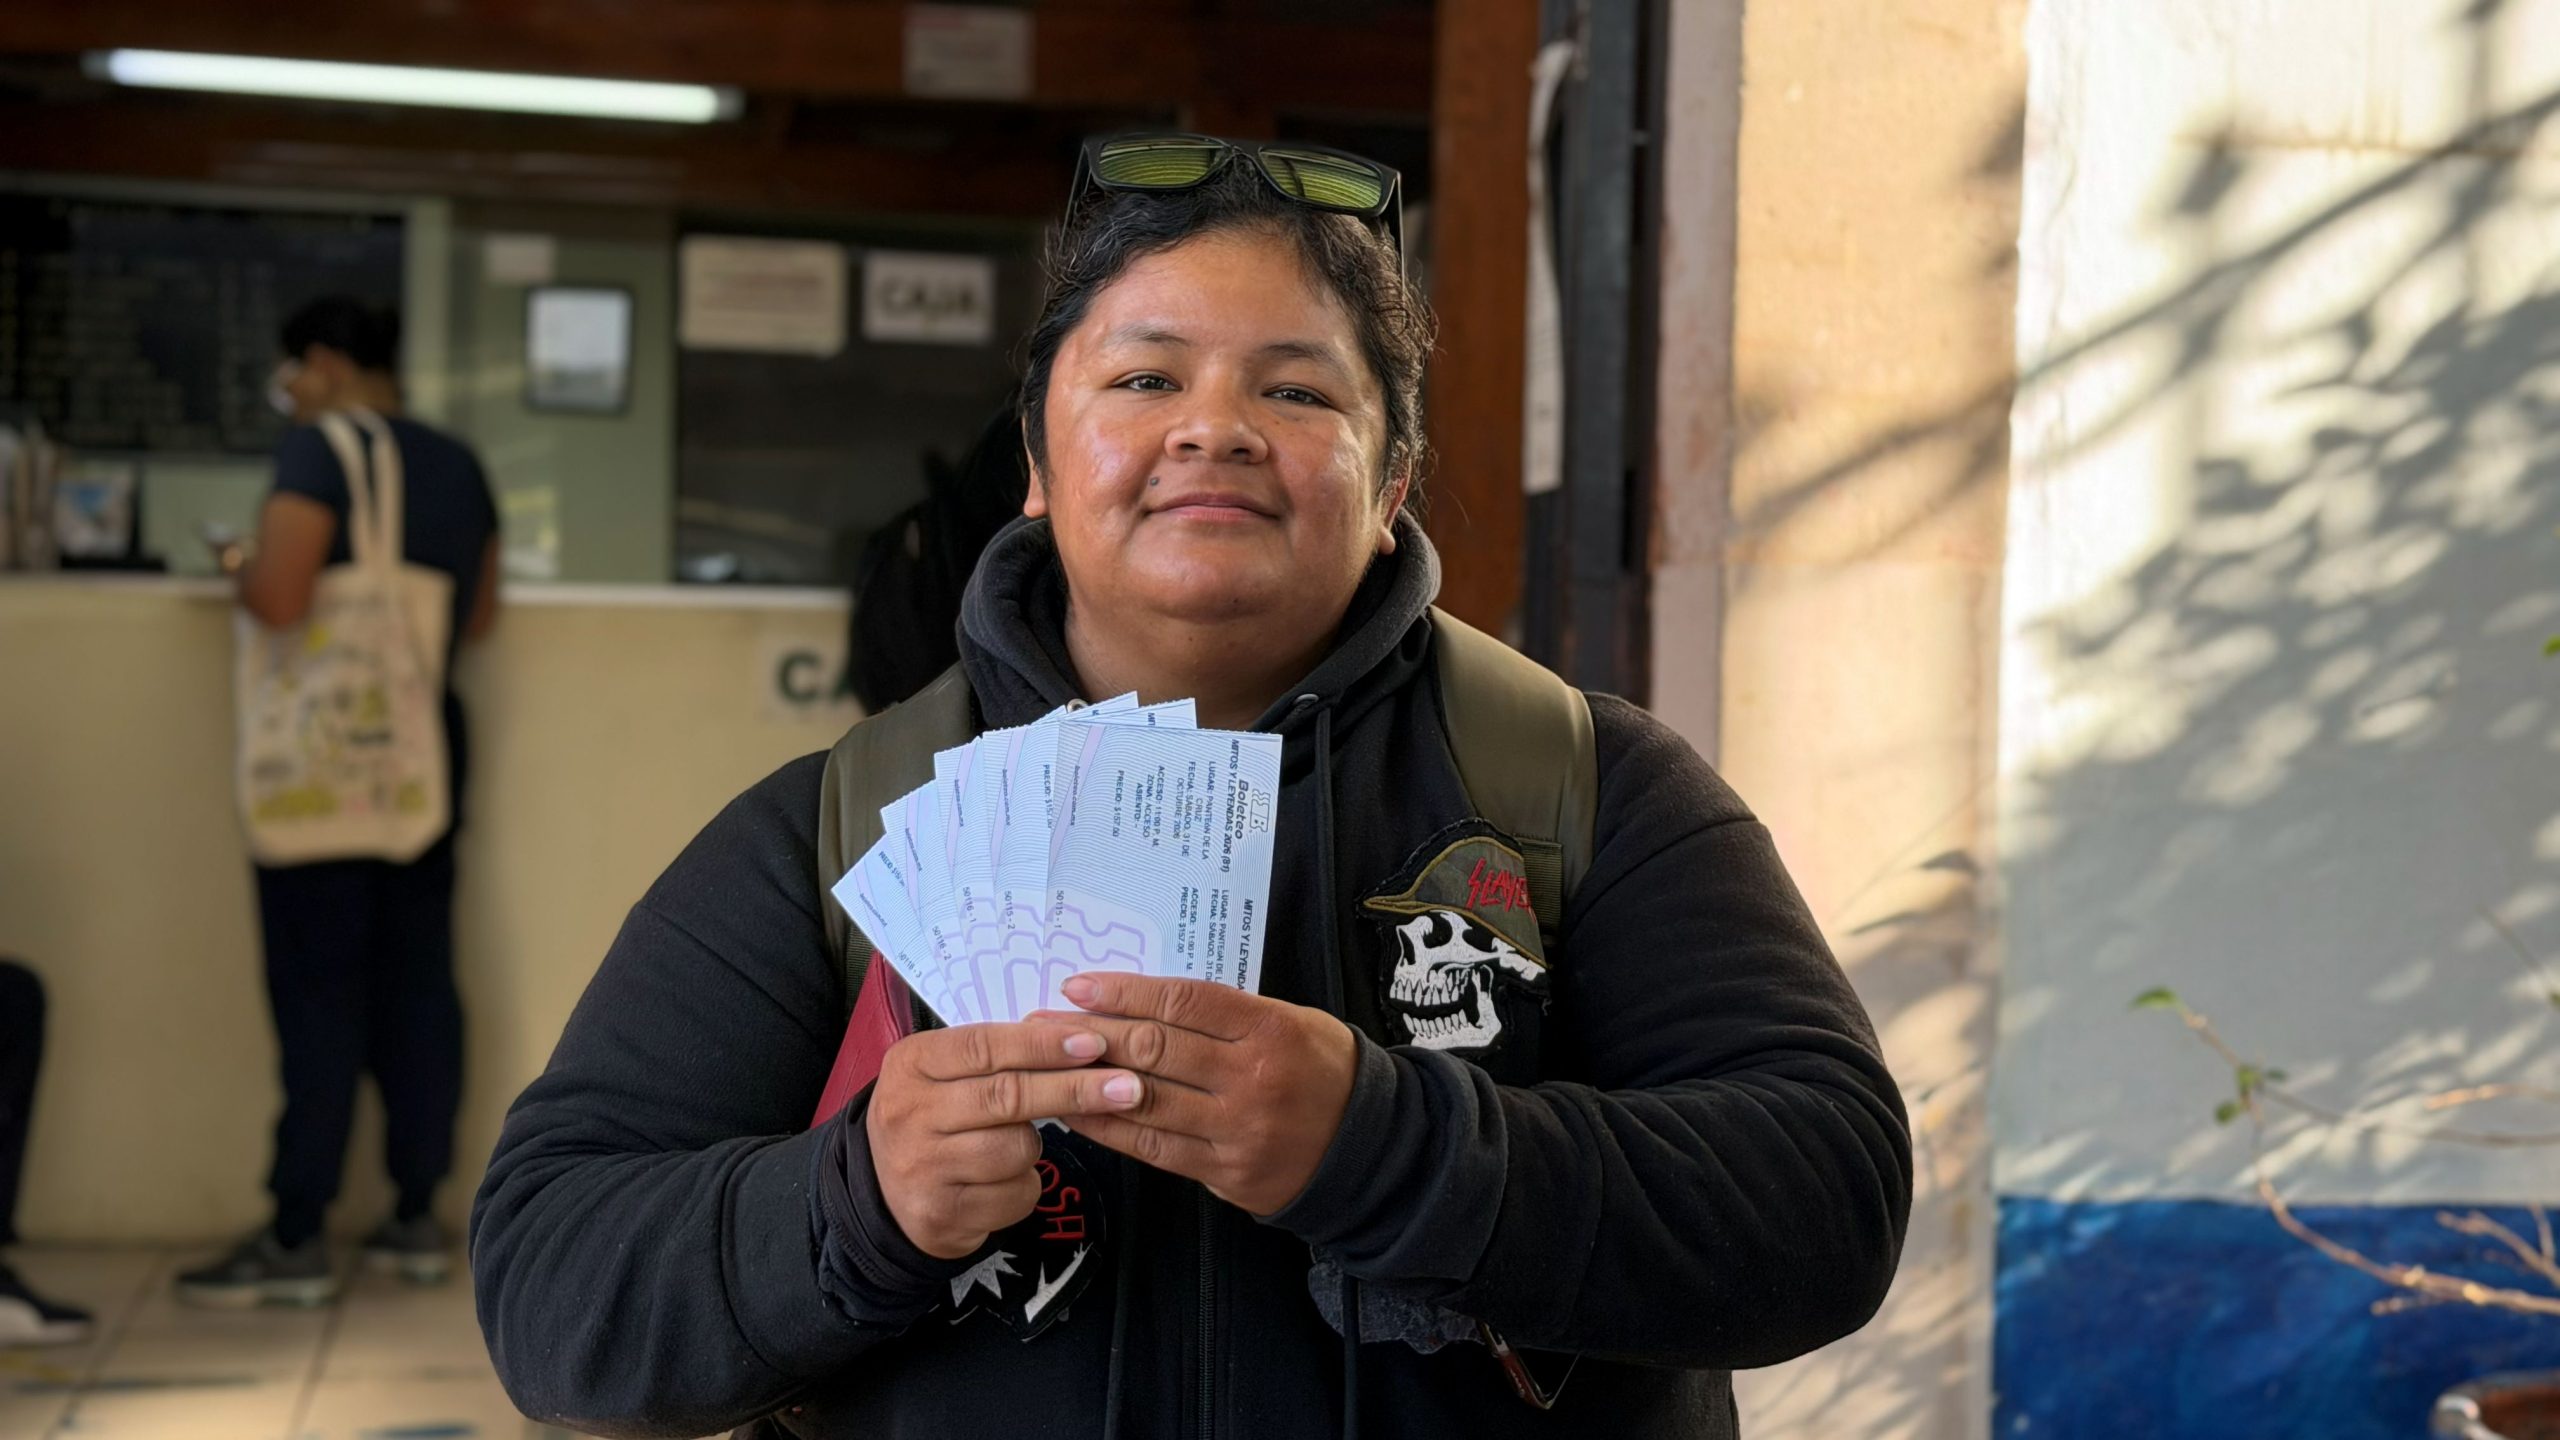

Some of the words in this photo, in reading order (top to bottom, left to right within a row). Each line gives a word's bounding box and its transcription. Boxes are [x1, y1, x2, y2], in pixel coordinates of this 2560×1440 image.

[1229, 739, 1240, 770] MITOS
[1114, 770, 1124, 805] PRECIO:
[1155, 765, 1165, 804] ACCESO:
[1186, 761, 1196, 793] FECHA:
[1206, 761, 1216, 794] LUGAR:
[1133, 783, 1144, 822] ASIENTO:
[1174, 777, 1185, 818] OCTUBRE
[1194, 798, 1203, 822] CRUZ
[1224, 779, 1237, 832] LEYENDAS
[1234, 779, 1249, 840] Boleteo
[1112, 806, 1121, 838] $157.00
[1142, 802, 1152, 838] ACCESO
[1153, 806, 1162, 827] 11:00
[1181, 844, 1189, 857] DE
[1182, 833, 1190, 843] 31
[1202, 835, 1210, 848] DE
[1222, 833, 1232, 854] 2026
[1201, 849, 1209, 860] LA
[1055, 890, 1064, 916] 50115
[1179, 886, 1189, 921] PRECIO:
[1209, 888, 1219, 920] FECHA:
[1219, 889, 1229, 921] LUGAR:
[1465, 856, 1537, 923] SLAYE
[1189, 887, 1199, 925] ACCESO:
[1242, 898, 1253, 932] MITOS
[1176, 923, 1186, 954] $157.00
[1241, 934, 1250, 942] Y
[1205, 960, 1213, 970] 31
[1215, 963, 1223, 975] DE
[1237, 942, 1249, 991] LEYENDA
